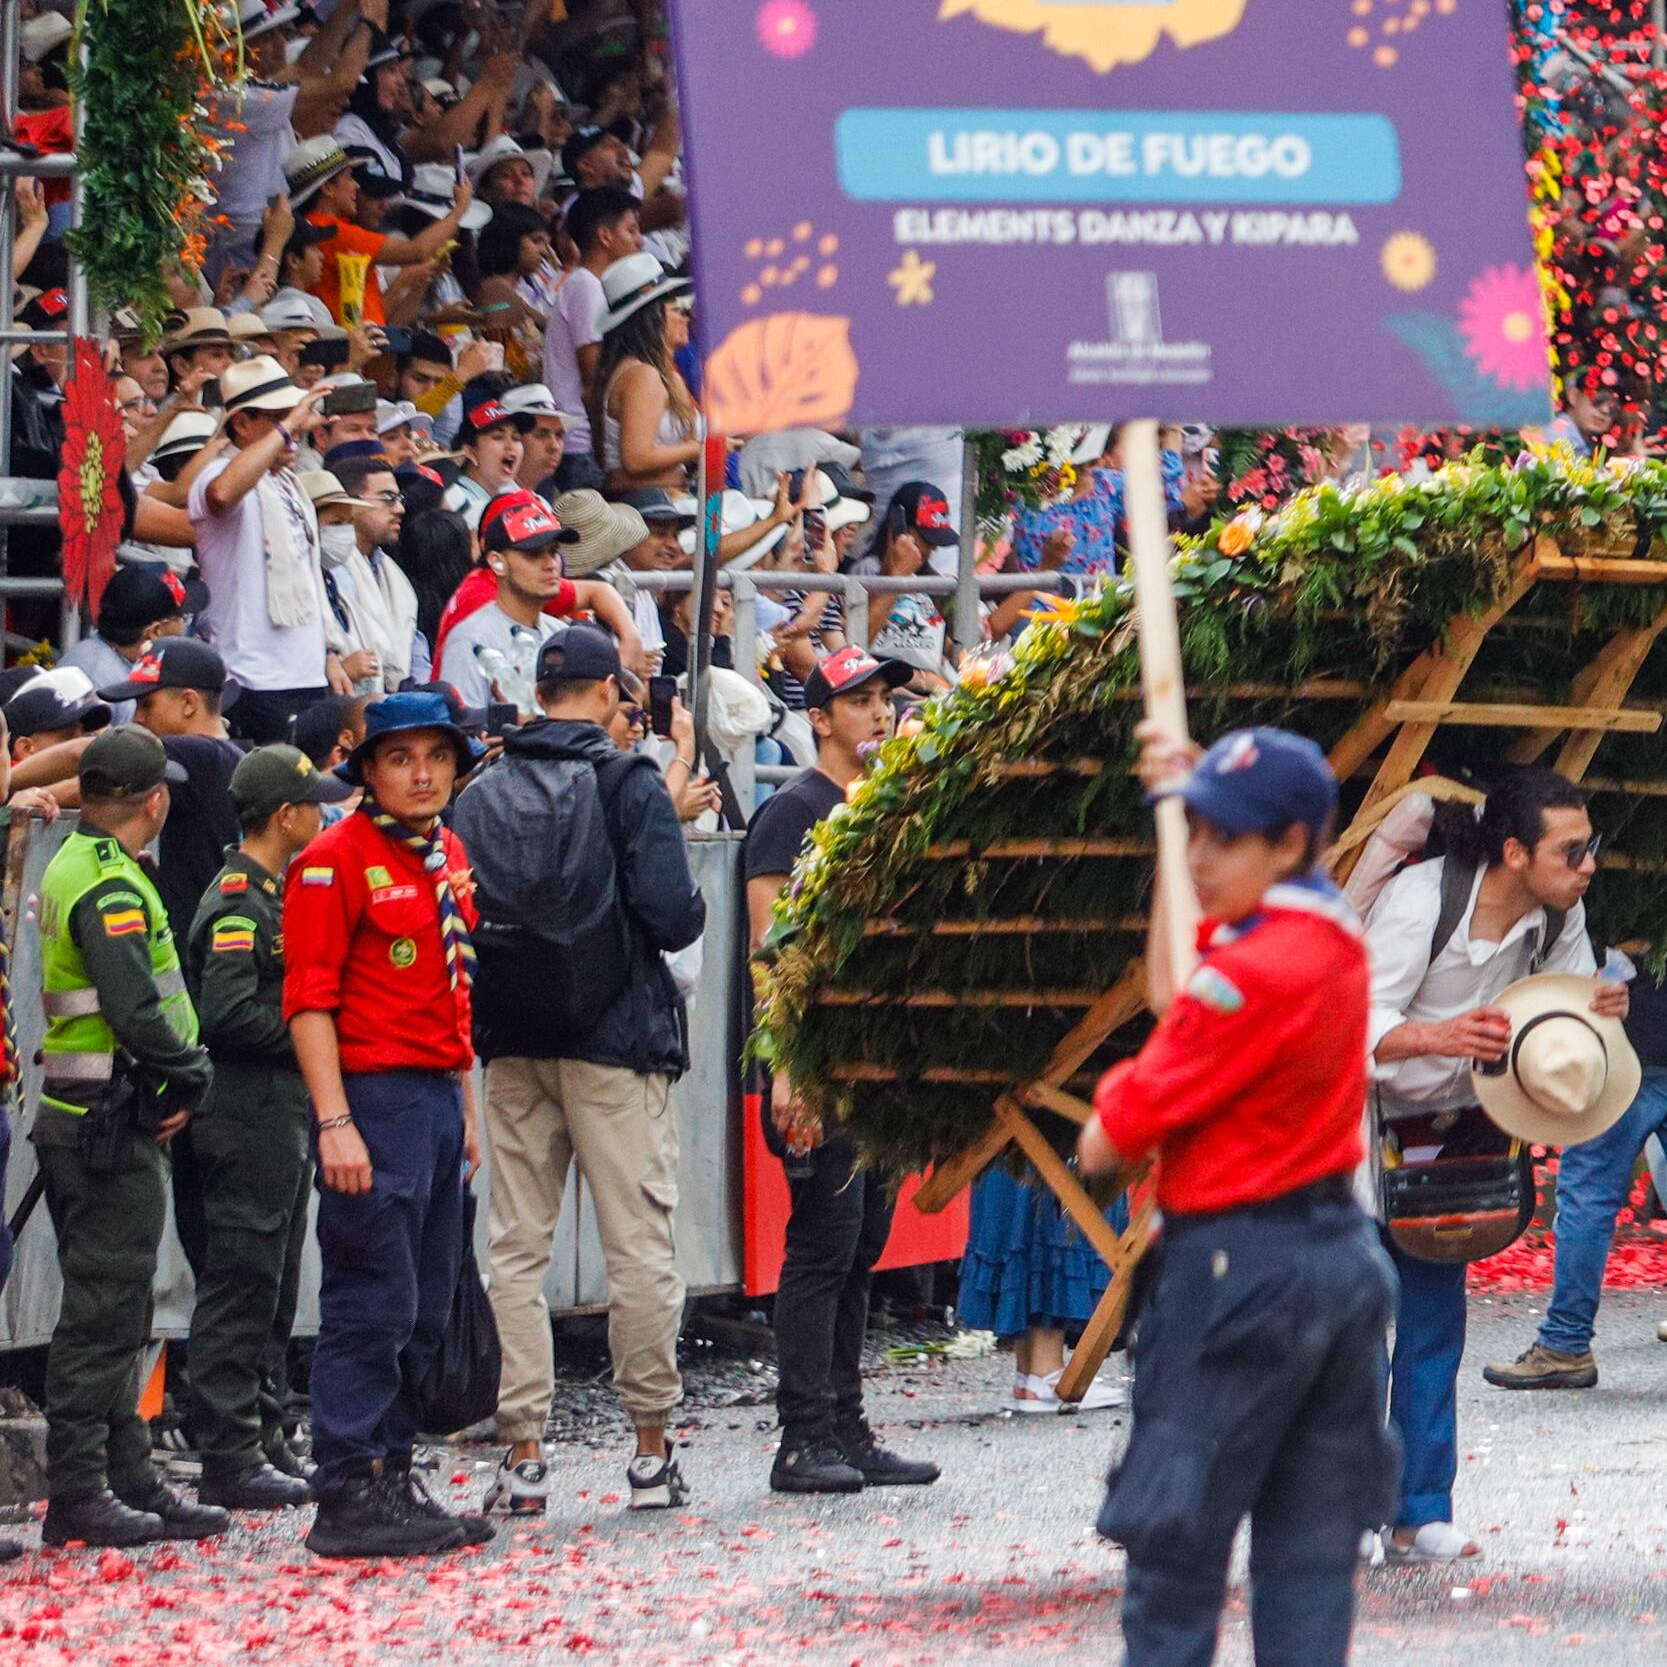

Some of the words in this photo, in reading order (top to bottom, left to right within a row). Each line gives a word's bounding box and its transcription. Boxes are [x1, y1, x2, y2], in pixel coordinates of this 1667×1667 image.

[927, 131, 1060, 177] LIRIO
[1066, 132, 1138, 177] DE
[1142, 133, 1313, 179] FUEGO
[893, 207, 1076, 245] ELEMENTS
[1077, 208, 1202, 245] DANZA
[1202, 210, 1230, 245] Y
[1230, 211, 1359, 246] KIPARA
